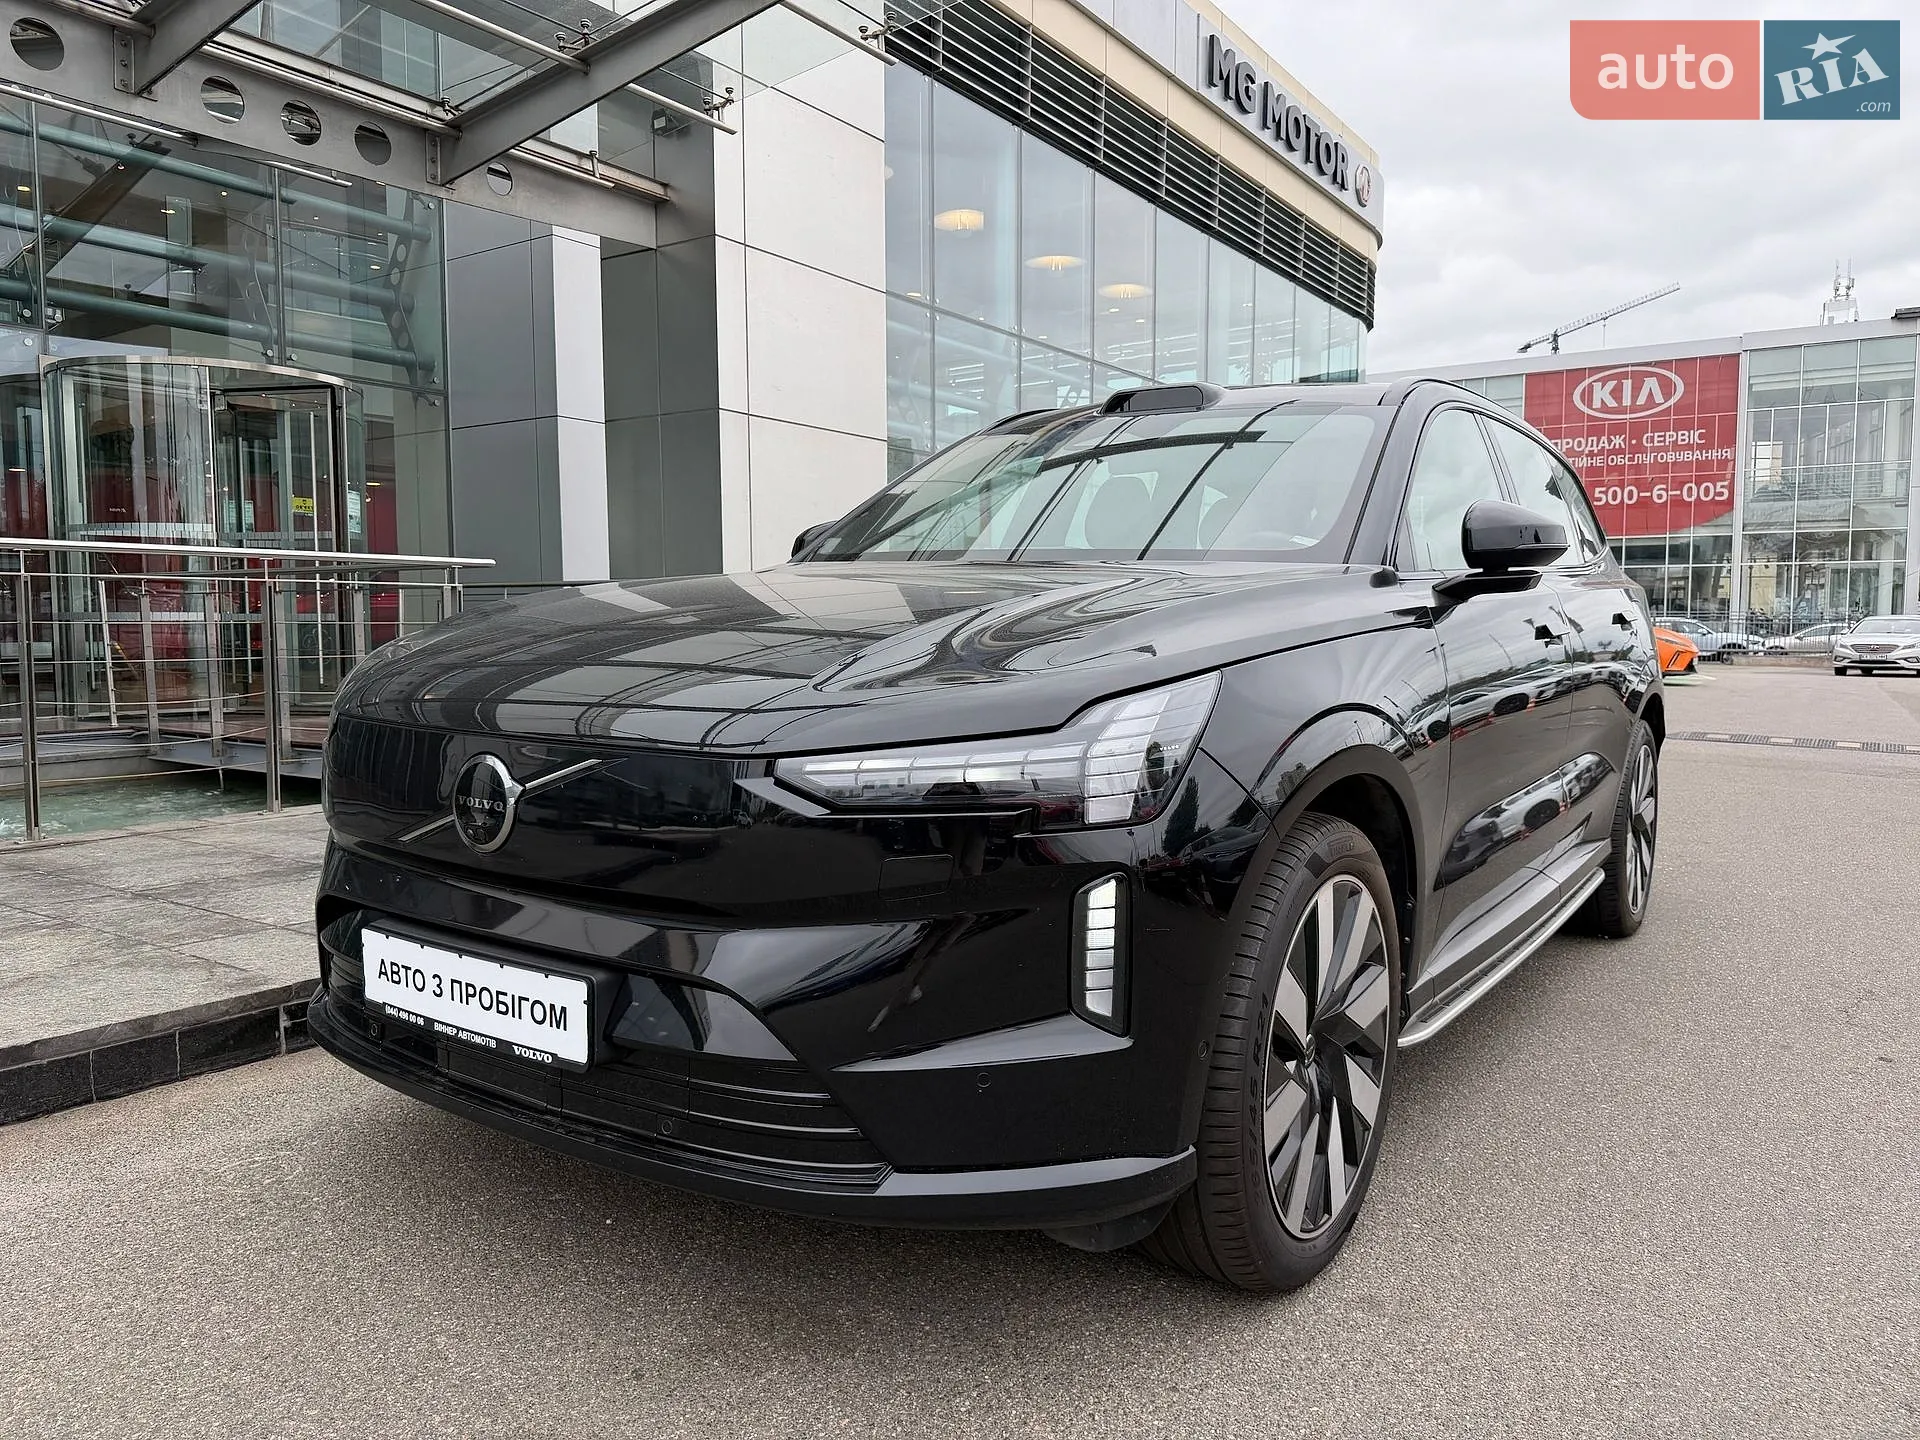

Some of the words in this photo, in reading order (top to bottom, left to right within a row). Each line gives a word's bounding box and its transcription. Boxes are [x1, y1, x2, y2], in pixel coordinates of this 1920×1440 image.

[1208, 34, 1257, 114] MG
[1262, 81, 1349, 191] MOTOR
[1592, 377, 1665, 409] KIA
[1551, 434, 1625, 453] ПРОДАЖ
[1642, 429, 1707, 447] СЕРВІС
[1566, 454, 1604, 468] ТІЙНЕ
[1608, 448, 1731, 467] ОБСЛУГОВУВАННЯ
[1594, 482, 1729, 505] 500-6-005
[458, 796, 504, 812] VOLVO
[378, 958, 426, 992] АВТО
[450, 978, 568, 1031] ПРОБІГОМ
[434, 1022, 458, 1036] ВІННЕР
[458, 1030, 497, 1048] АВТОМОТІВ
[512, 1045, 553, 1064] VOLVO
